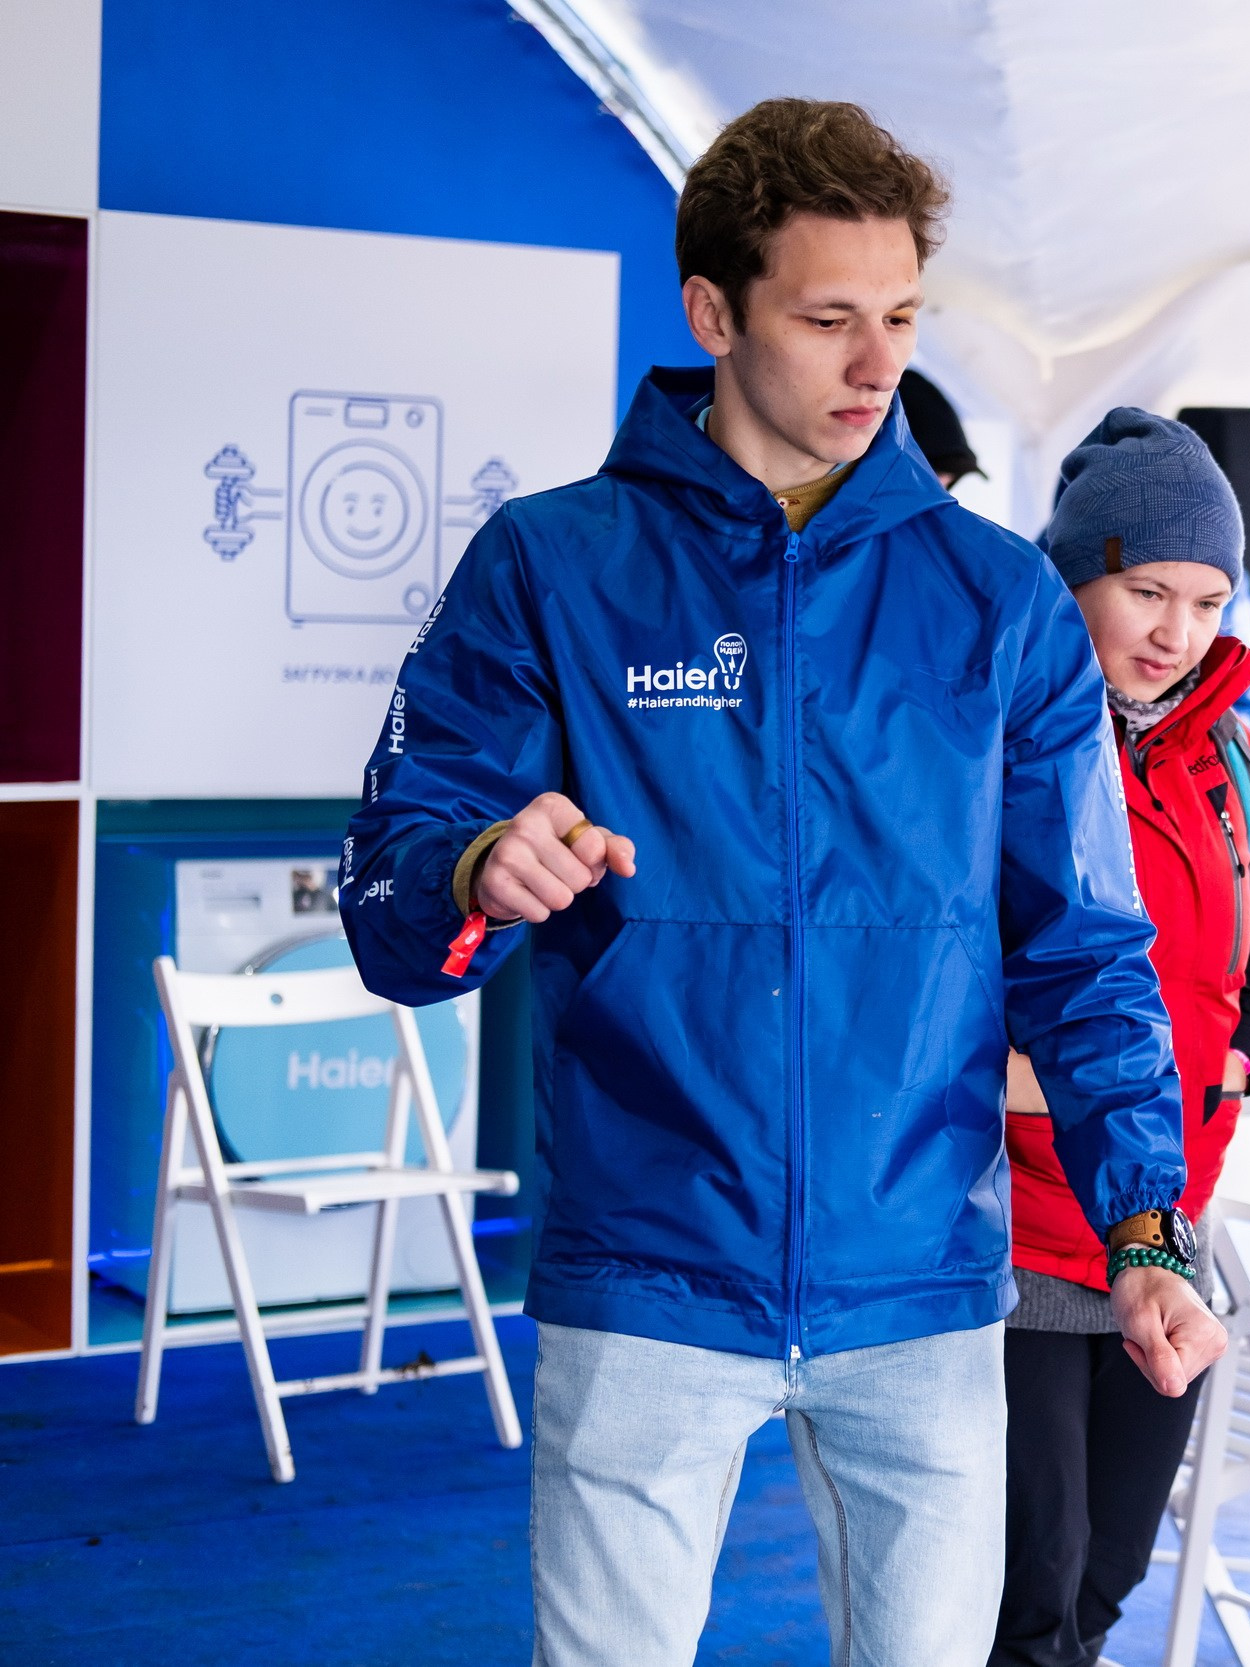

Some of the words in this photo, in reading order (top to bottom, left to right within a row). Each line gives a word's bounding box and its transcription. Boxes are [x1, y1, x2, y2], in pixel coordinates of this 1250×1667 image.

[627, 661, 718, 692] Haier
[627, 695, 742, 711] #Haierandhigher
[388, 684, 406, 754] Haier
